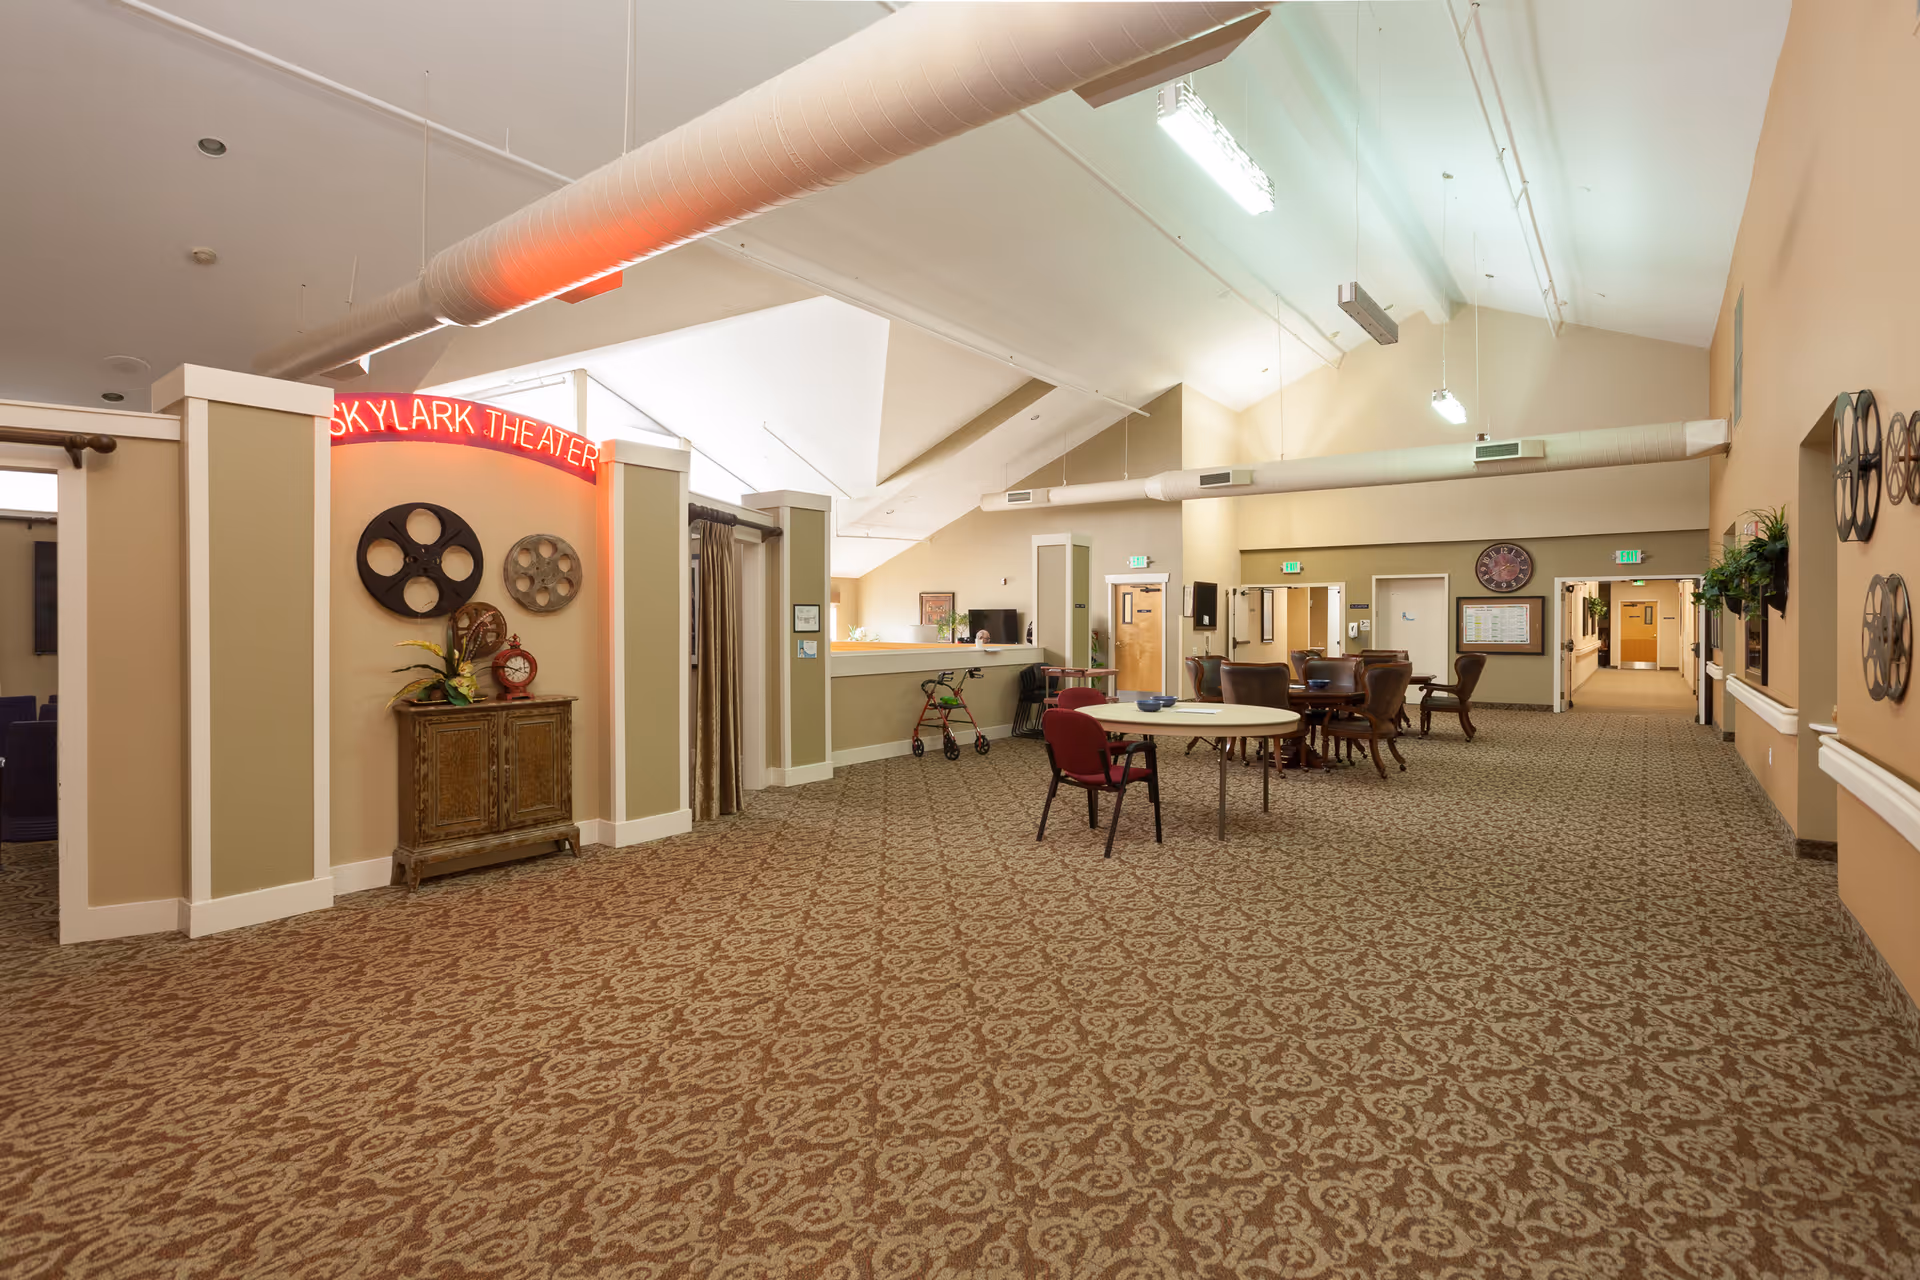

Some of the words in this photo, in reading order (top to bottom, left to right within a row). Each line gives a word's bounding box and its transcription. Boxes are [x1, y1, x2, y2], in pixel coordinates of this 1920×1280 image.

[329, 398, 475, 436] SKYLARK
[485, 408, 599, 471] THEATER
[1620, 550, 1639, 563] EXIT
[1285, 562, 1298, 572] EXIT
